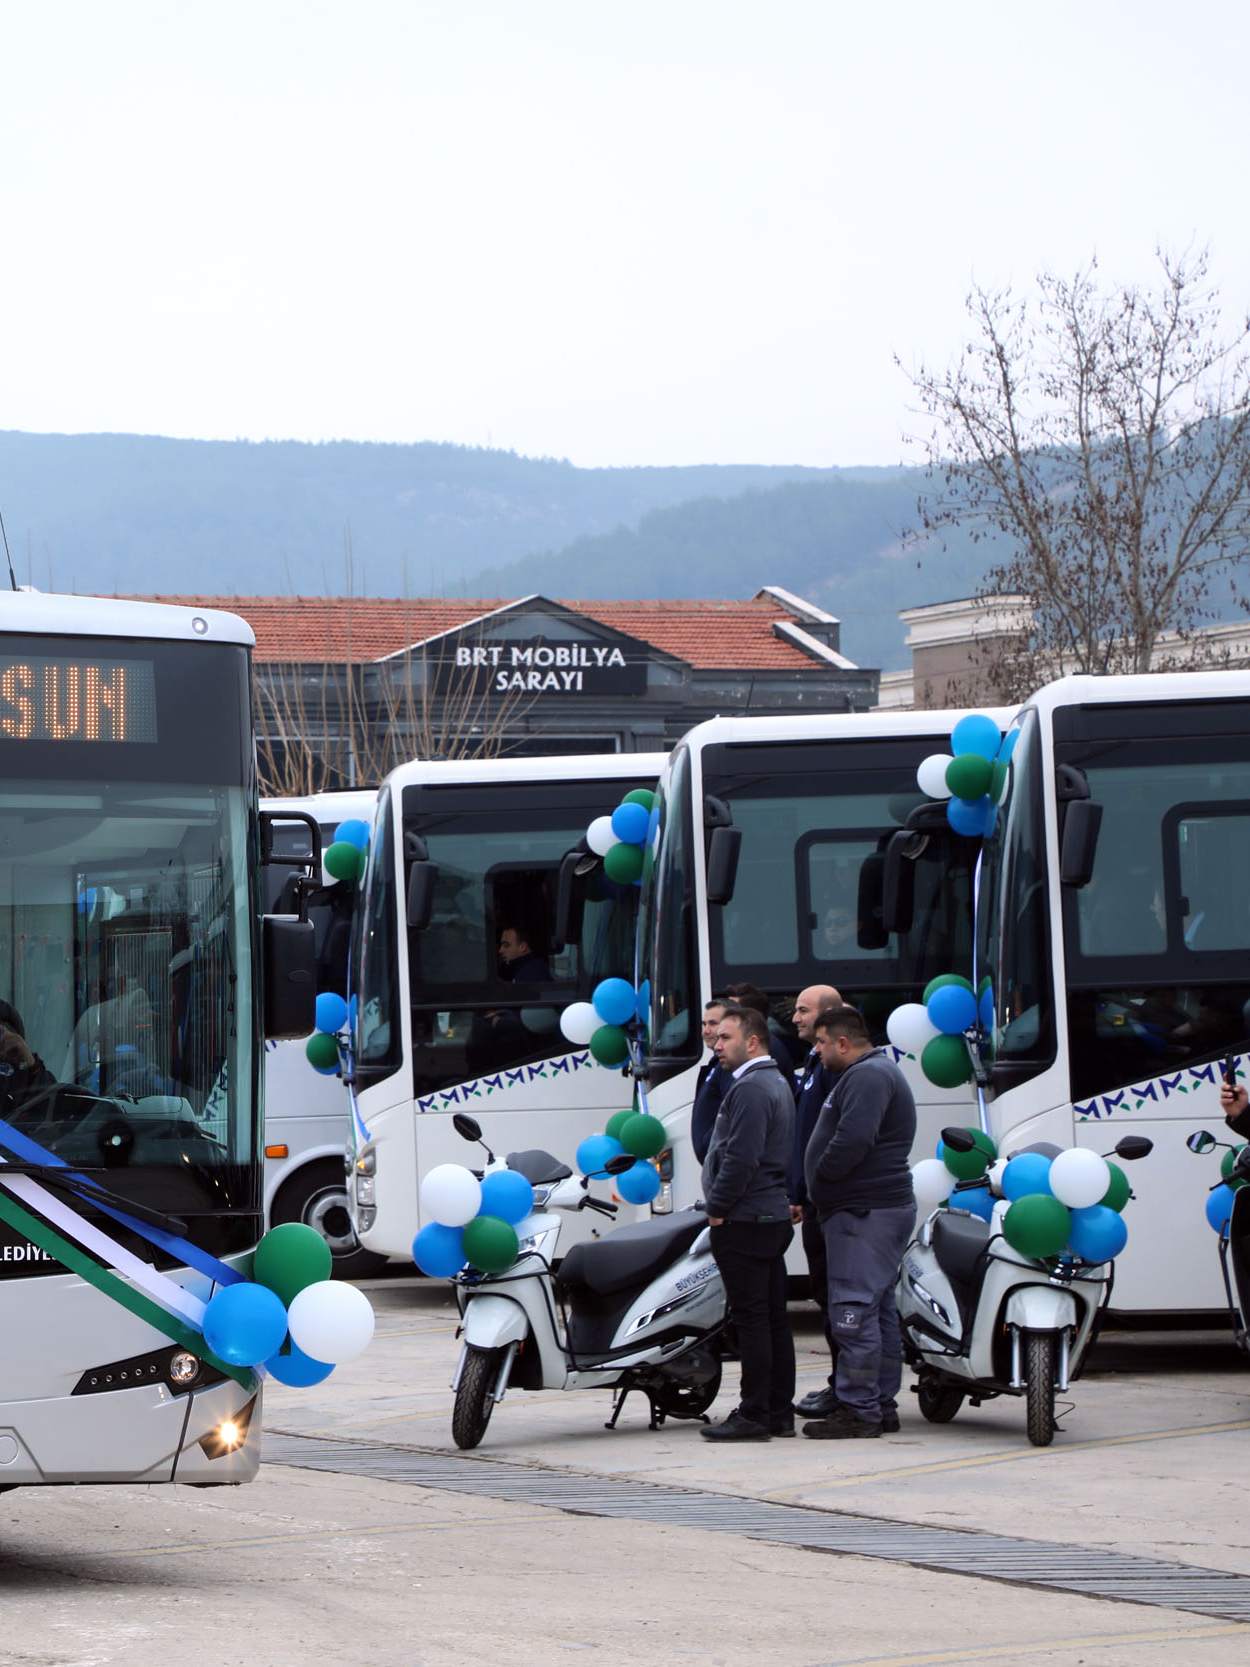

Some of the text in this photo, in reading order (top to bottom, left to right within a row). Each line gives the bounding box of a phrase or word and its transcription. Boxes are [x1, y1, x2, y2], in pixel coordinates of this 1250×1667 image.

[456, 643, 626, 667] BRT MOBİLYA
[496, 671, 584, 691] SARAYI
